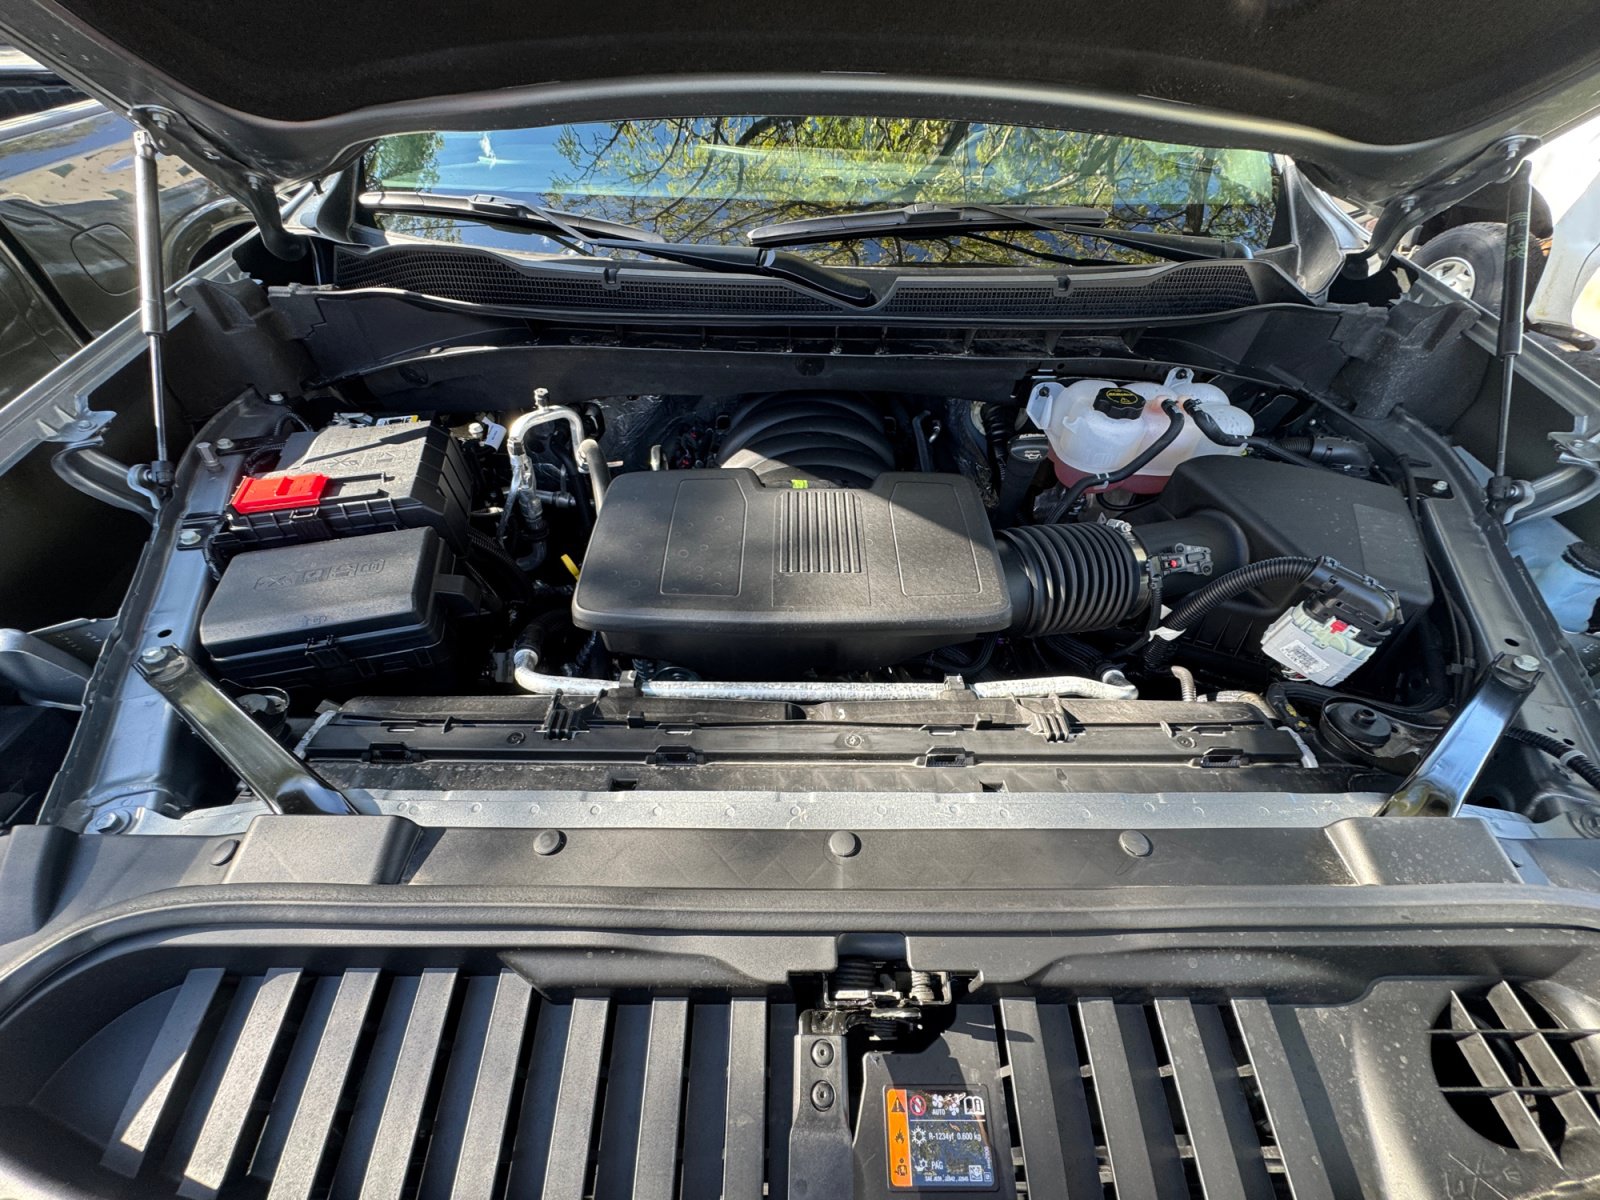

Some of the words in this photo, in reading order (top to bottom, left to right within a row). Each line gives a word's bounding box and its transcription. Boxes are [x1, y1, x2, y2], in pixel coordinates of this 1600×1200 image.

[928, 1132, 954, 1141] R-1234yf
[974, 1132, 982, 1141] kg
[931, 1161, 943, 1170] PAG
